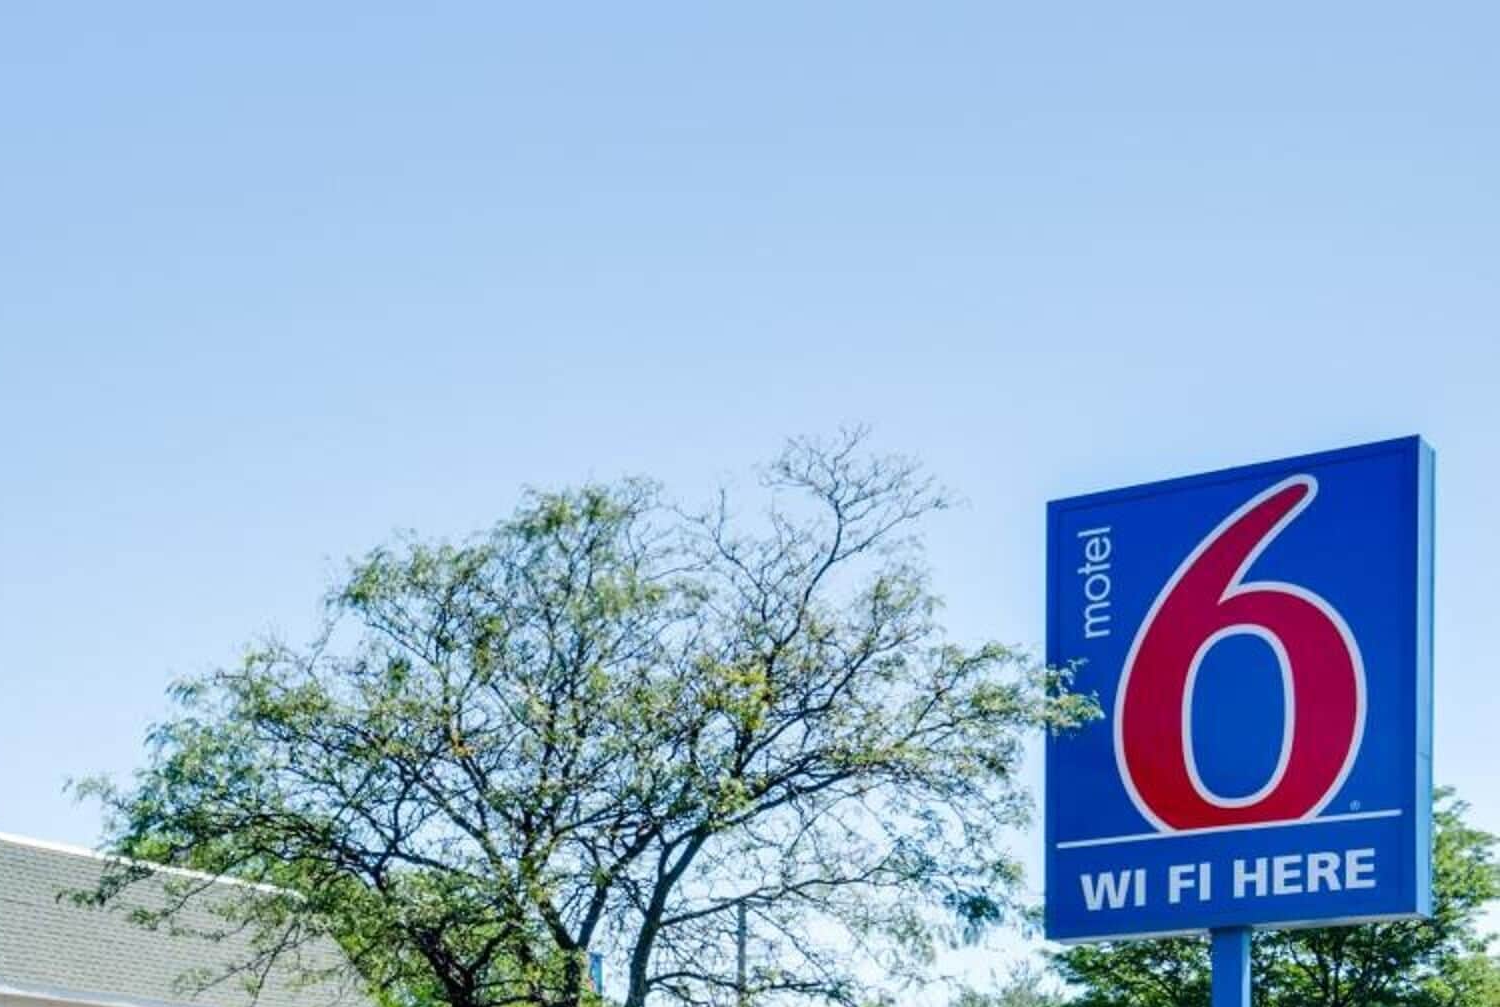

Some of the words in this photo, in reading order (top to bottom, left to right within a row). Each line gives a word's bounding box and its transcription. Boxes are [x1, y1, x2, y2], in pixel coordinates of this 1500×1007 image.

[1077, 526, 1111, 639] motel
[1113, 473, 1367, 833] 6
[1080, 868, 1147, 911] WI
[1168, 862, 1211, 904] FI
[1233, 847, 1376, 899] HERE
